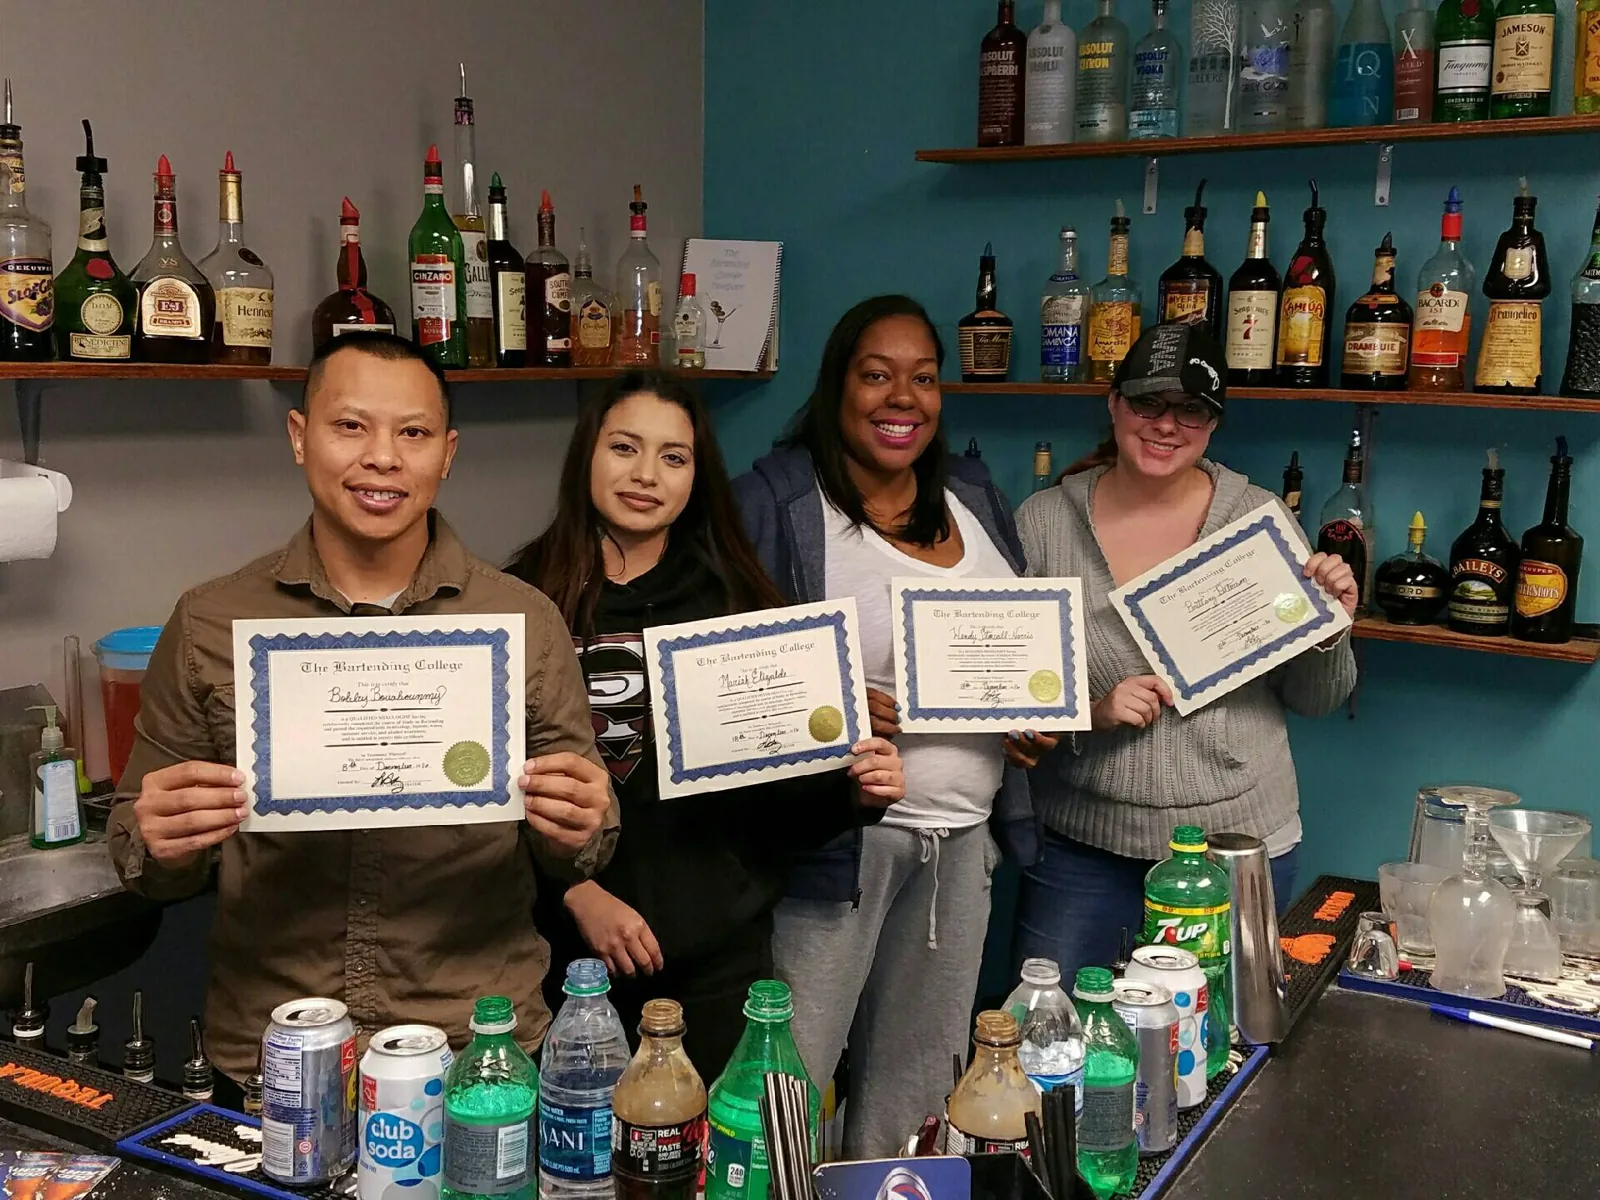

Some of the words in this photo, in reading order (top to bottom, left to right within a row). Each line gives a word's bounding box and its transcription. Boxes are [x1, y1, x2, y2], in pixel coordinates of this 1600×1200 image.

[1501, 23, 1546, 38] JAMESON
[1079, 42, 1114, 54] ABSOLUT
[1399, 28, 1418, 60] X
[1135, 52, 1169, 61] ABSOLUT
[1079, 57, 1110, 70] CITRON
[1443, 59, 1489, 71] Tanqueray
[1135, 65, 1164, 75] VODKA
[413, 271, 452, 282] CINZANO
[465, 263, 490, 284] GALLI
[550, 279, 570, 290] SOUTH
[552, 290, 571, 299] COMF
[1168, 295, 1206, 305] MYERS'S
[160, 301, 182, 312] E&J
[1284, 297, 1323, 318] KAHLÚA
[1418, 298, 1461, 308] BACARDI
[1233, 305, 1268, 317] Seagram's
[1489, 306, 1538, 323] Frangelico
[1242, 318, 1259, 341] 7
[73, 336, 129, 346] BENEDICTINE
[1347, 342, 1396, 352] DRAMBUIE
[1453, 560, 1504, 579] BAILEYS
[1158, 593, 1177, 606] The
[1178, 567, 1226, 595] Bartending
[1225, 548, 1256, 569] College
[933, 609, 951, 620] The
[953, 608, 1006, 620] Bartending
[1006, 608, 1041, 620] College
[696, 657, 718, 668] The
[720, 648, 778, 664] Bartending
[779, 641, 815, 657] College
[300, 661, 329, 676] The
[333, 660, 412, 675] Bartending
[414, 659, 464, 674] College
[328, 686, 369, 708] Bobby
[370, 1119, 414, 1140] club
[657, 1127, 681, 1138] REAL
[369, 1140, 417, 1160] soda
[658, 1143, 681, 1152] TASTE
[730, 1167, 744, 1176] 240
